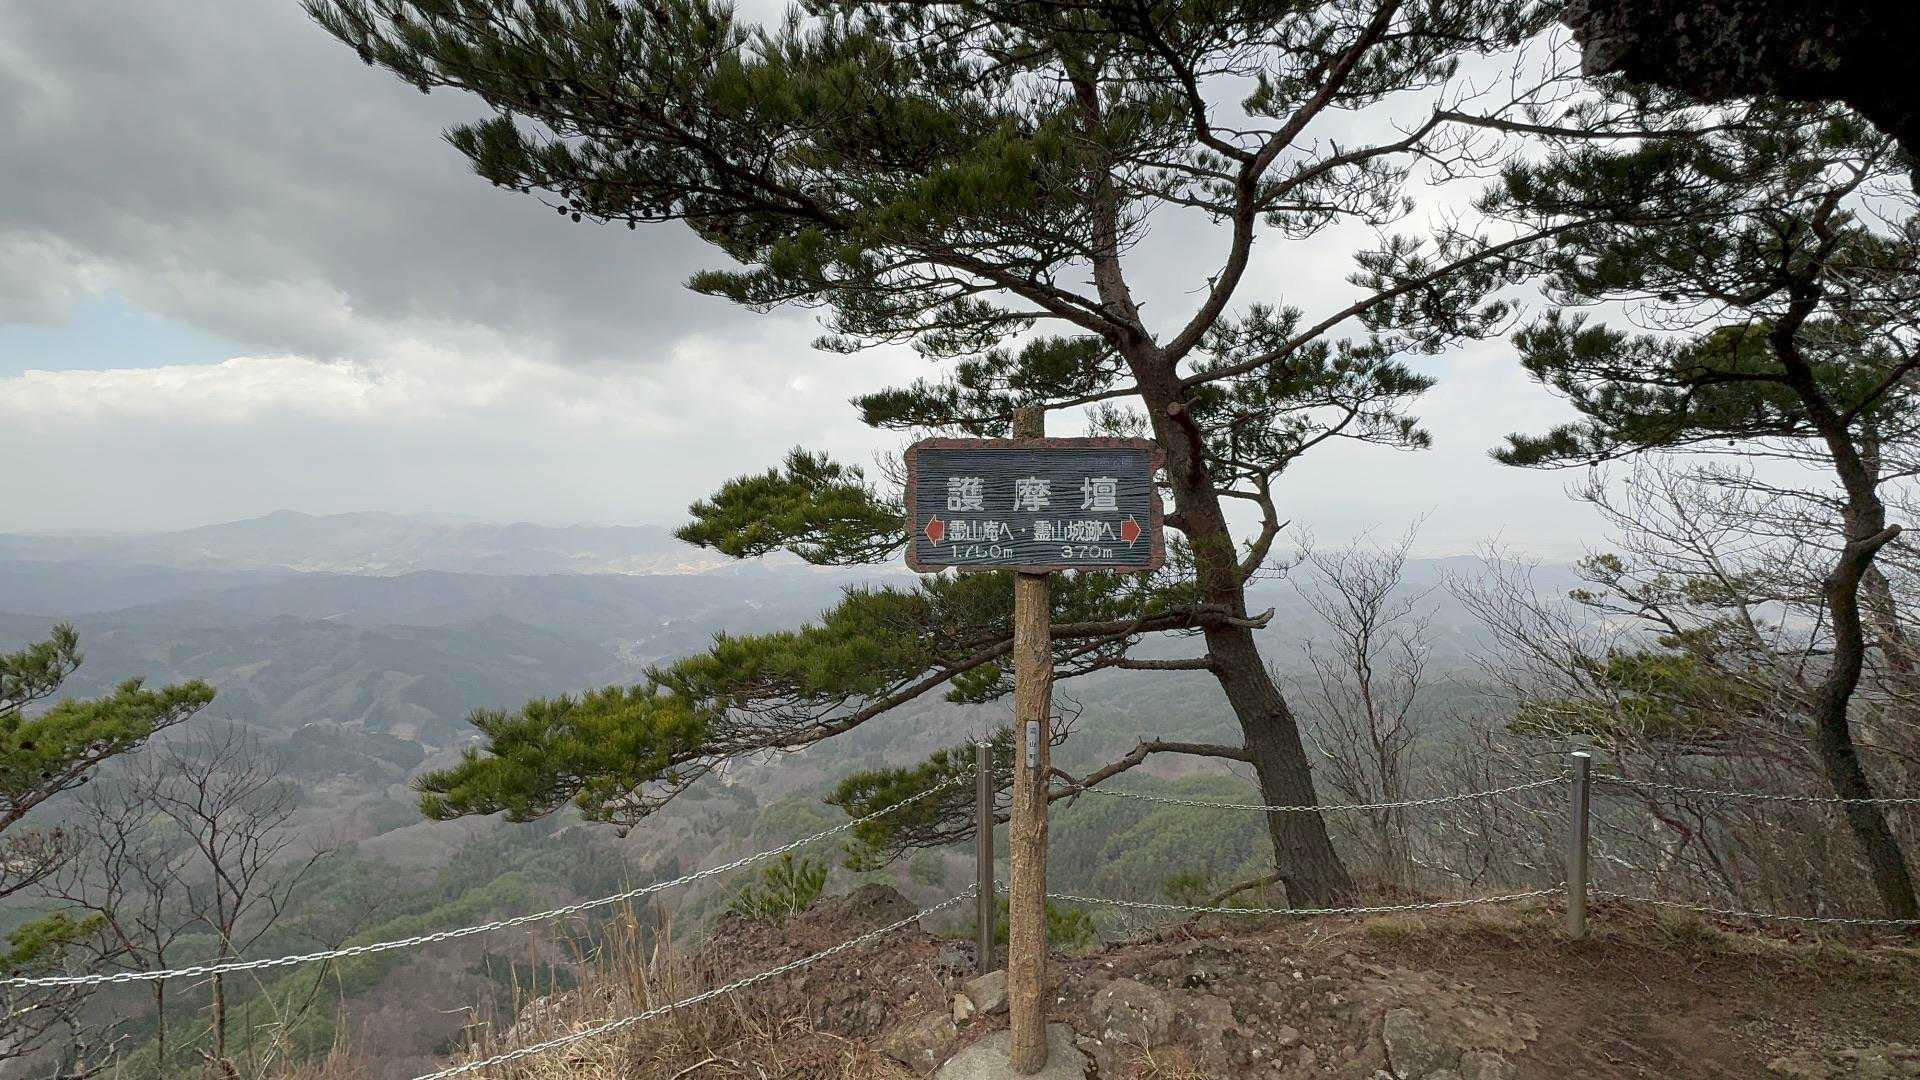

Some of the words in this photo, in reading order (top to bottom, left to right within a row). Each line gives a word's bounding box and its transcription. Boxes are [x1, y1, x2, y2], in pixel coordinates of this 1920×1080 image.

[946, 476, 1119, 512] 護摩壇
[1060, 544, 1113, 559] 370m
